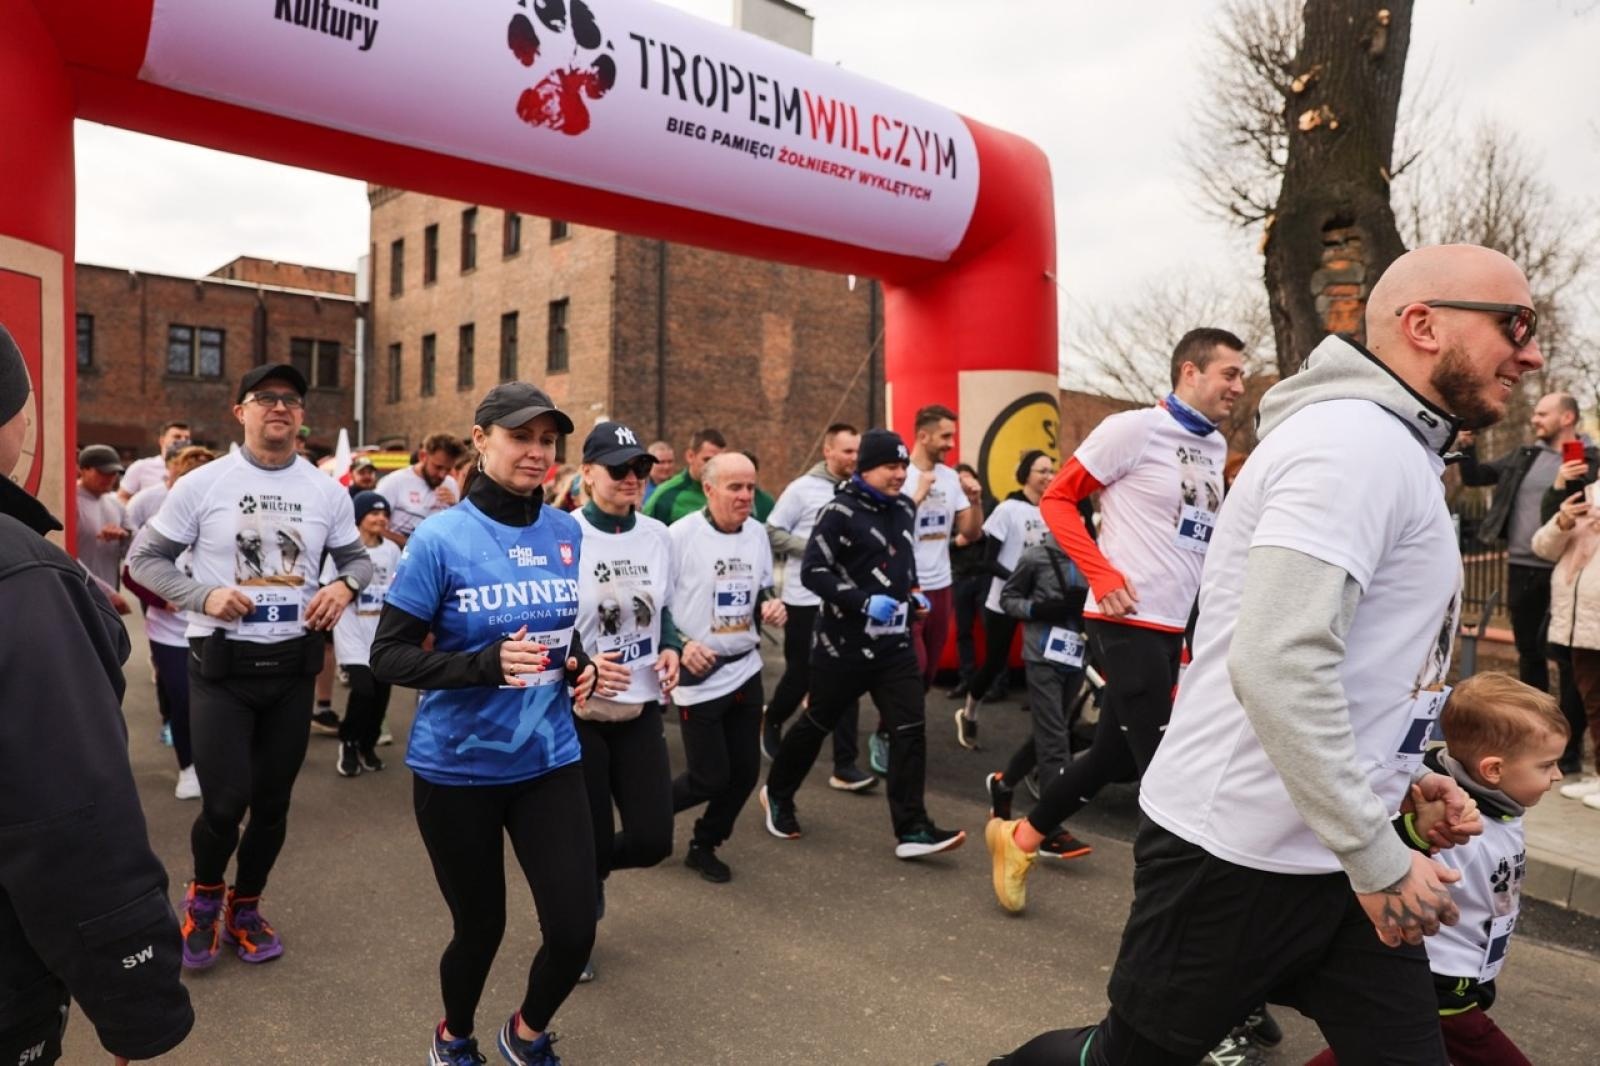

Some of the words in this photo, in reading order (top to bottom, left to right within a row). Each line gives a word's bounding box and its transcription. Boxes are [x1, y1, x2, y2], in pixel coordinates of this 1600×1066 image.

[666, 117, 706, 140] BIEG
[711, 129, 775, 160] PAMIĘCI
[777, 145, 856, 181] ŻOŁNIERZY
[859, 170, 932, 201] WYKLĘTYCH
[260, 501, 302, 512] WILCZYM
[1192, 523, 1207, 541] 94
[613, 566, 648, 577] WILCZYM
[456, 579, 578, 613] RUNNER
[731, 591, 747, 606] 29
[267, 605, 280, 622] 8
[620, 643, 640, 662] 70
[122, 945, 153, 969] SW
[18, 1040, 46, 1066] SW
